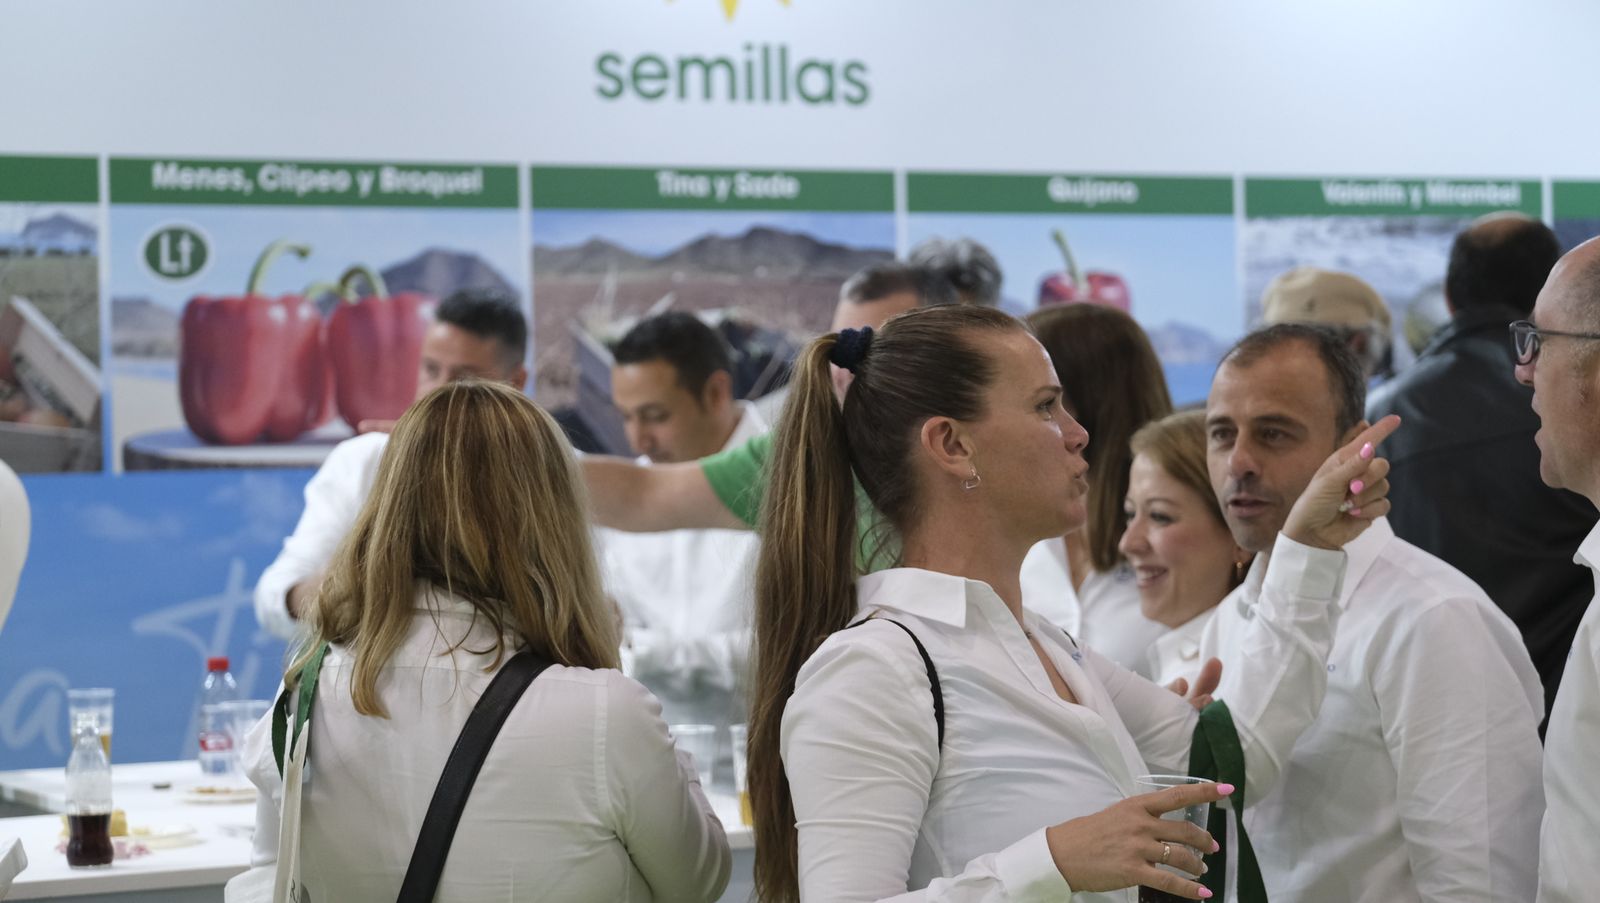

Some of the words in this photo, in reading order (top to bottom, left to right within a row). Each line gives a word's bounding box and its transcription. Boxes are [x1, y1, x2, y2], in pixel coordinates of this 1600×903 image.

[596, 44, 870, 105] semillas
[152, 161, 253, 196] Menes,
[257, 163, 351, 197] Clipeo
[357, 170, 374, 198] y
[380, 166, 483, 199] Broquel
[713, 176, 732, 202] y
[1407, 184, 1422, 210] y
